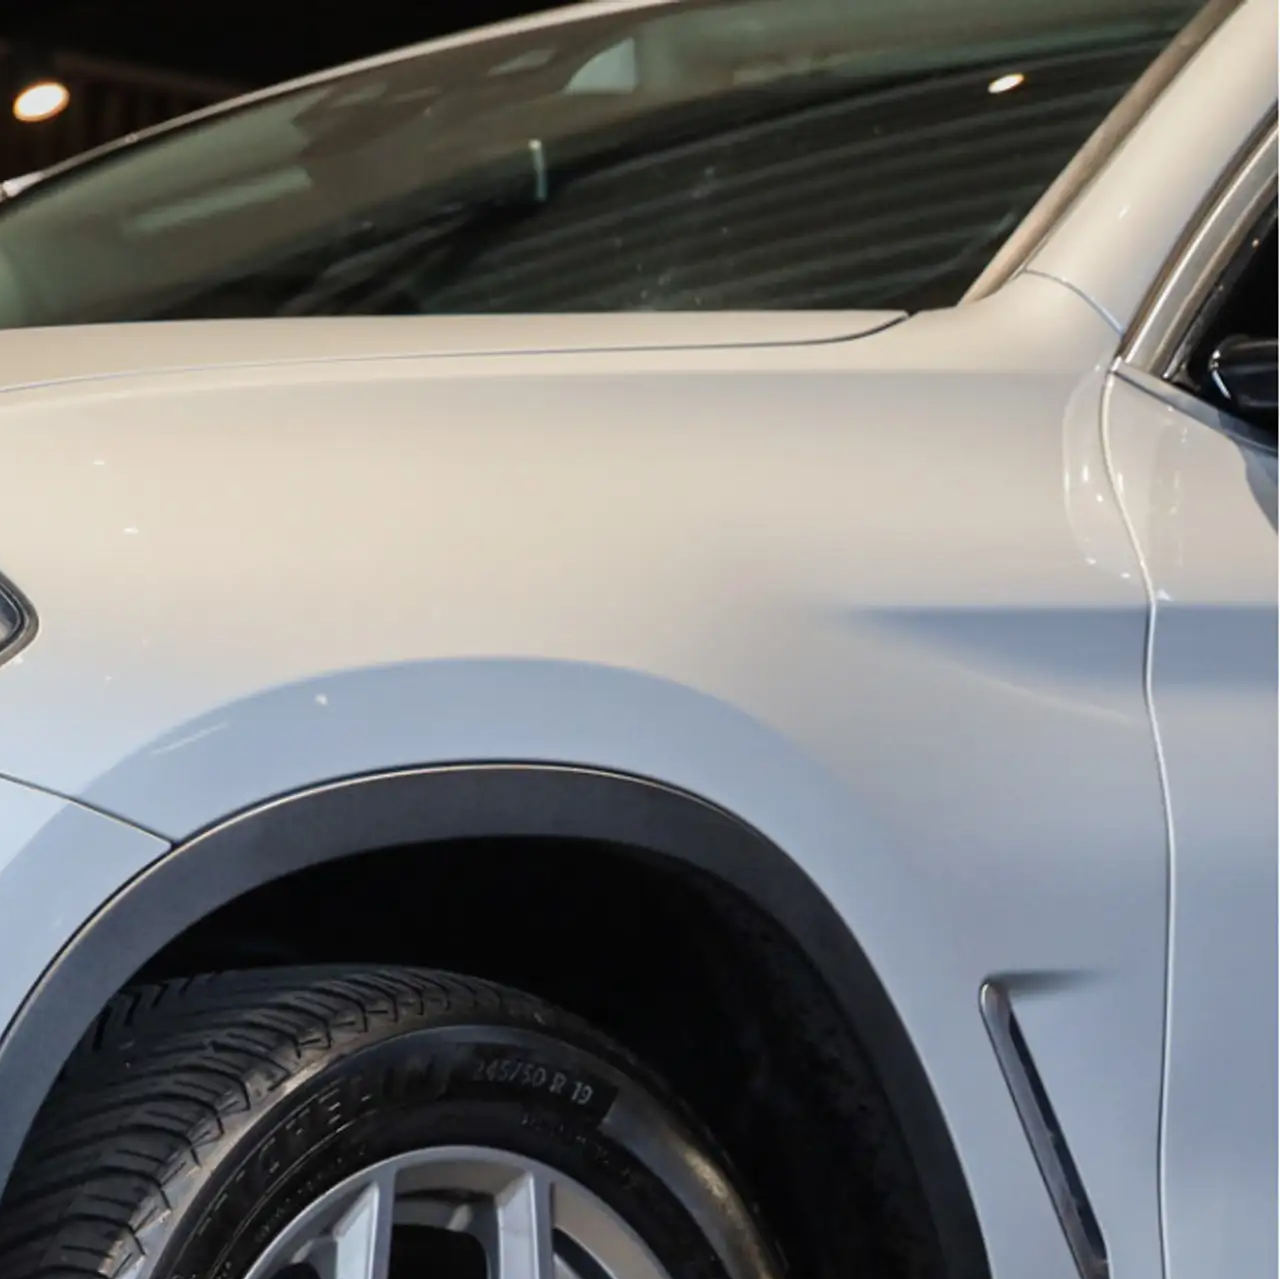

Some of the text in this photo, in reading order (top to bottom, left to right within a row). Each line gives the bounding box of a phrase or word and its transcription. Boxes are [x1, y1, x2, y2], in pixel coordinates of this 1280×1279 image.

[473, 1059, 594, 1105] 245/50 R 19
